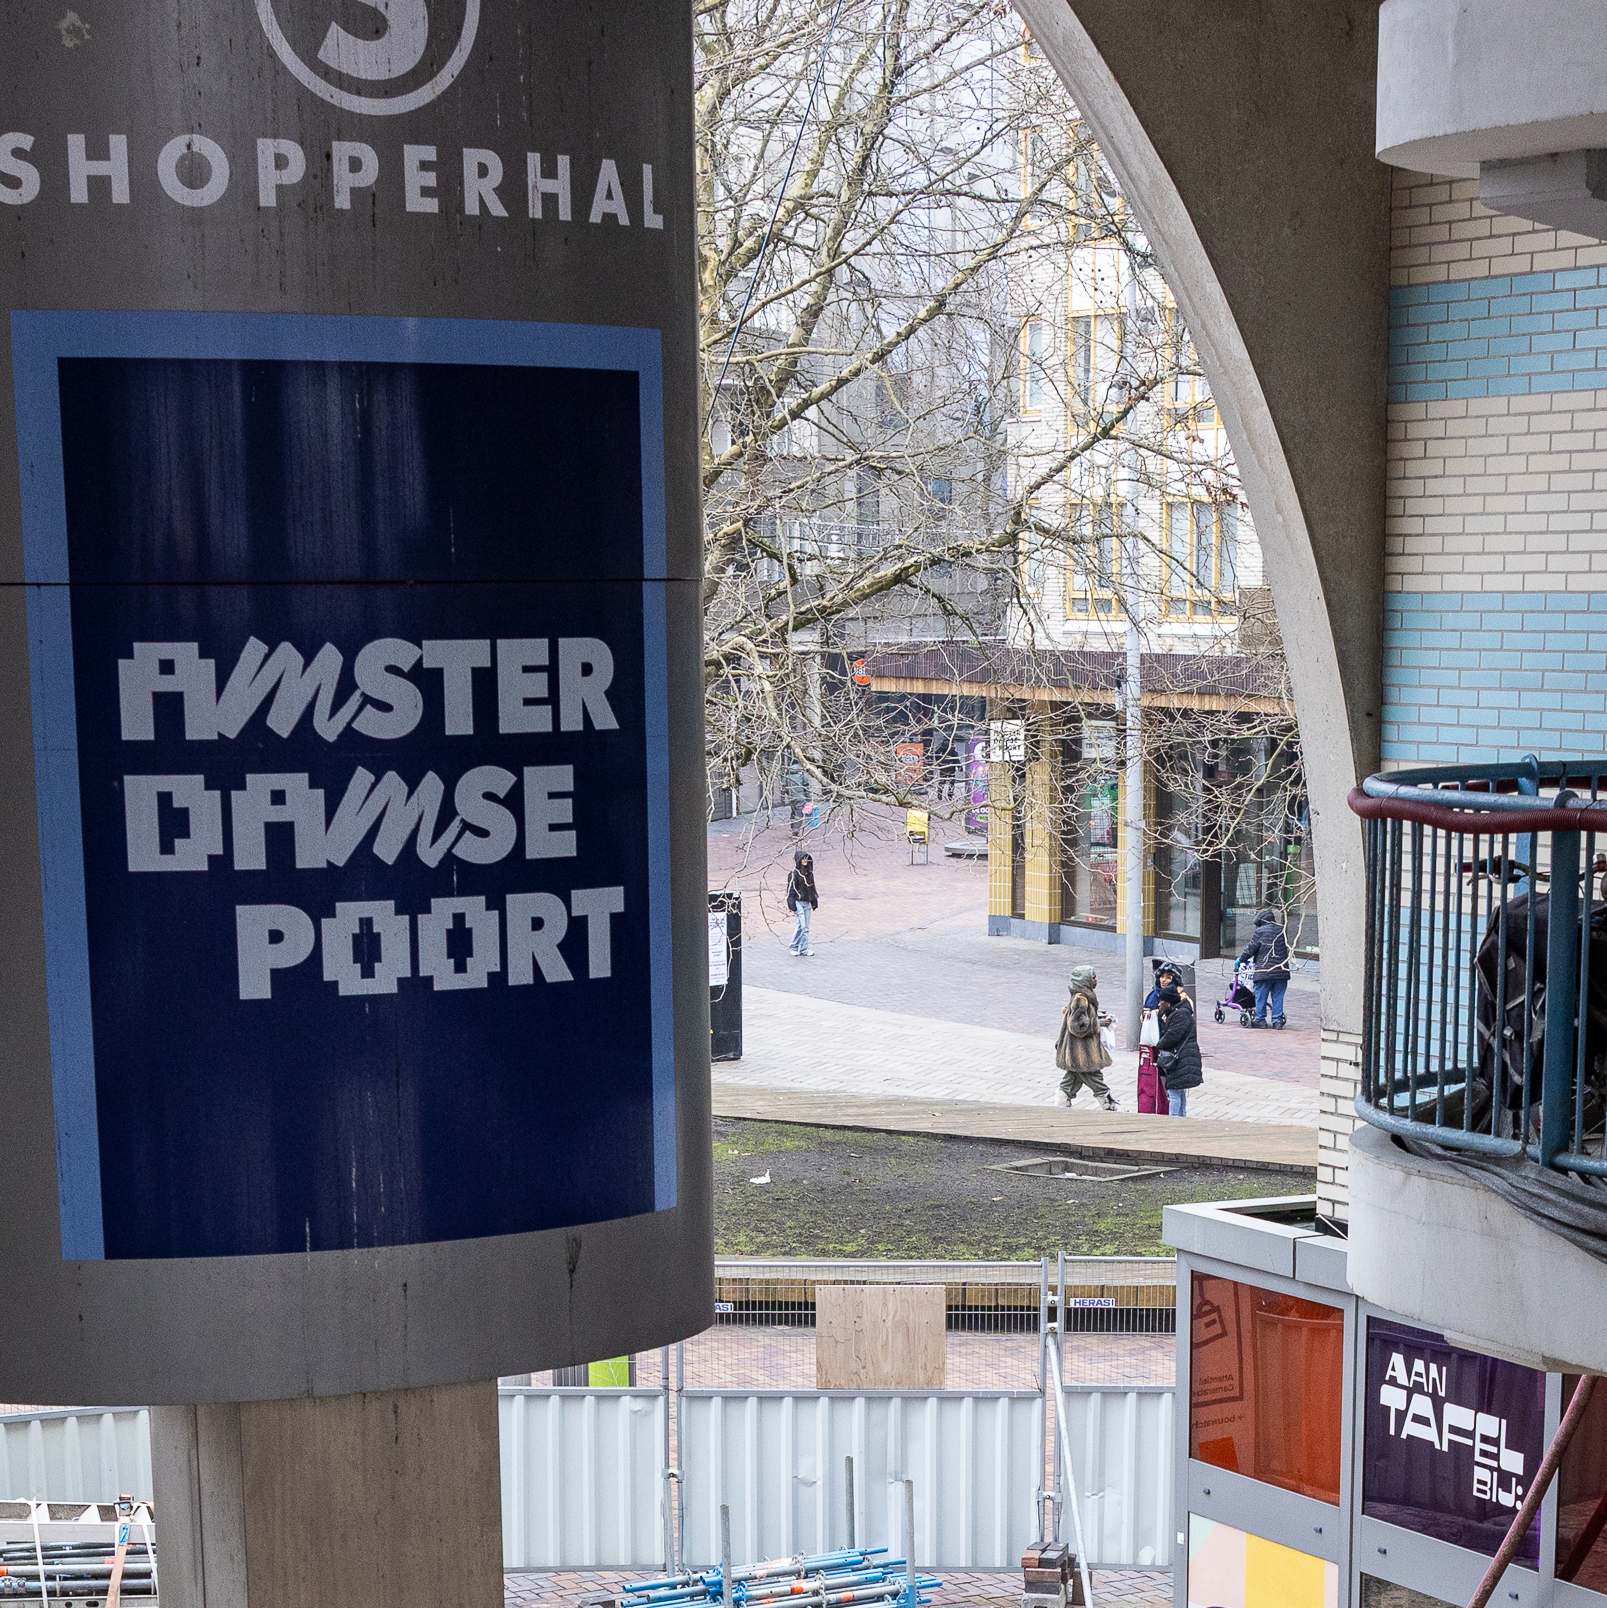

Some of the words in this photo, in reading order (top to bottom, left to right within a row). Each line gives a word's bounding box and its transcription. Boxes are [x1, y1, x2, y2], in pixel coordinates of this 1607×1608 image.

[118, 636, 620, 742] AMSTER
[123, 765, 577, 872] DAMSE
[235, 886, 624, 999] POORT
[1385, 1352, 1446, 1397] AAN
[1379, 1383, 1525, 1476] TAFEL
[1473, 1465, 1523, 1510] BIJ:
